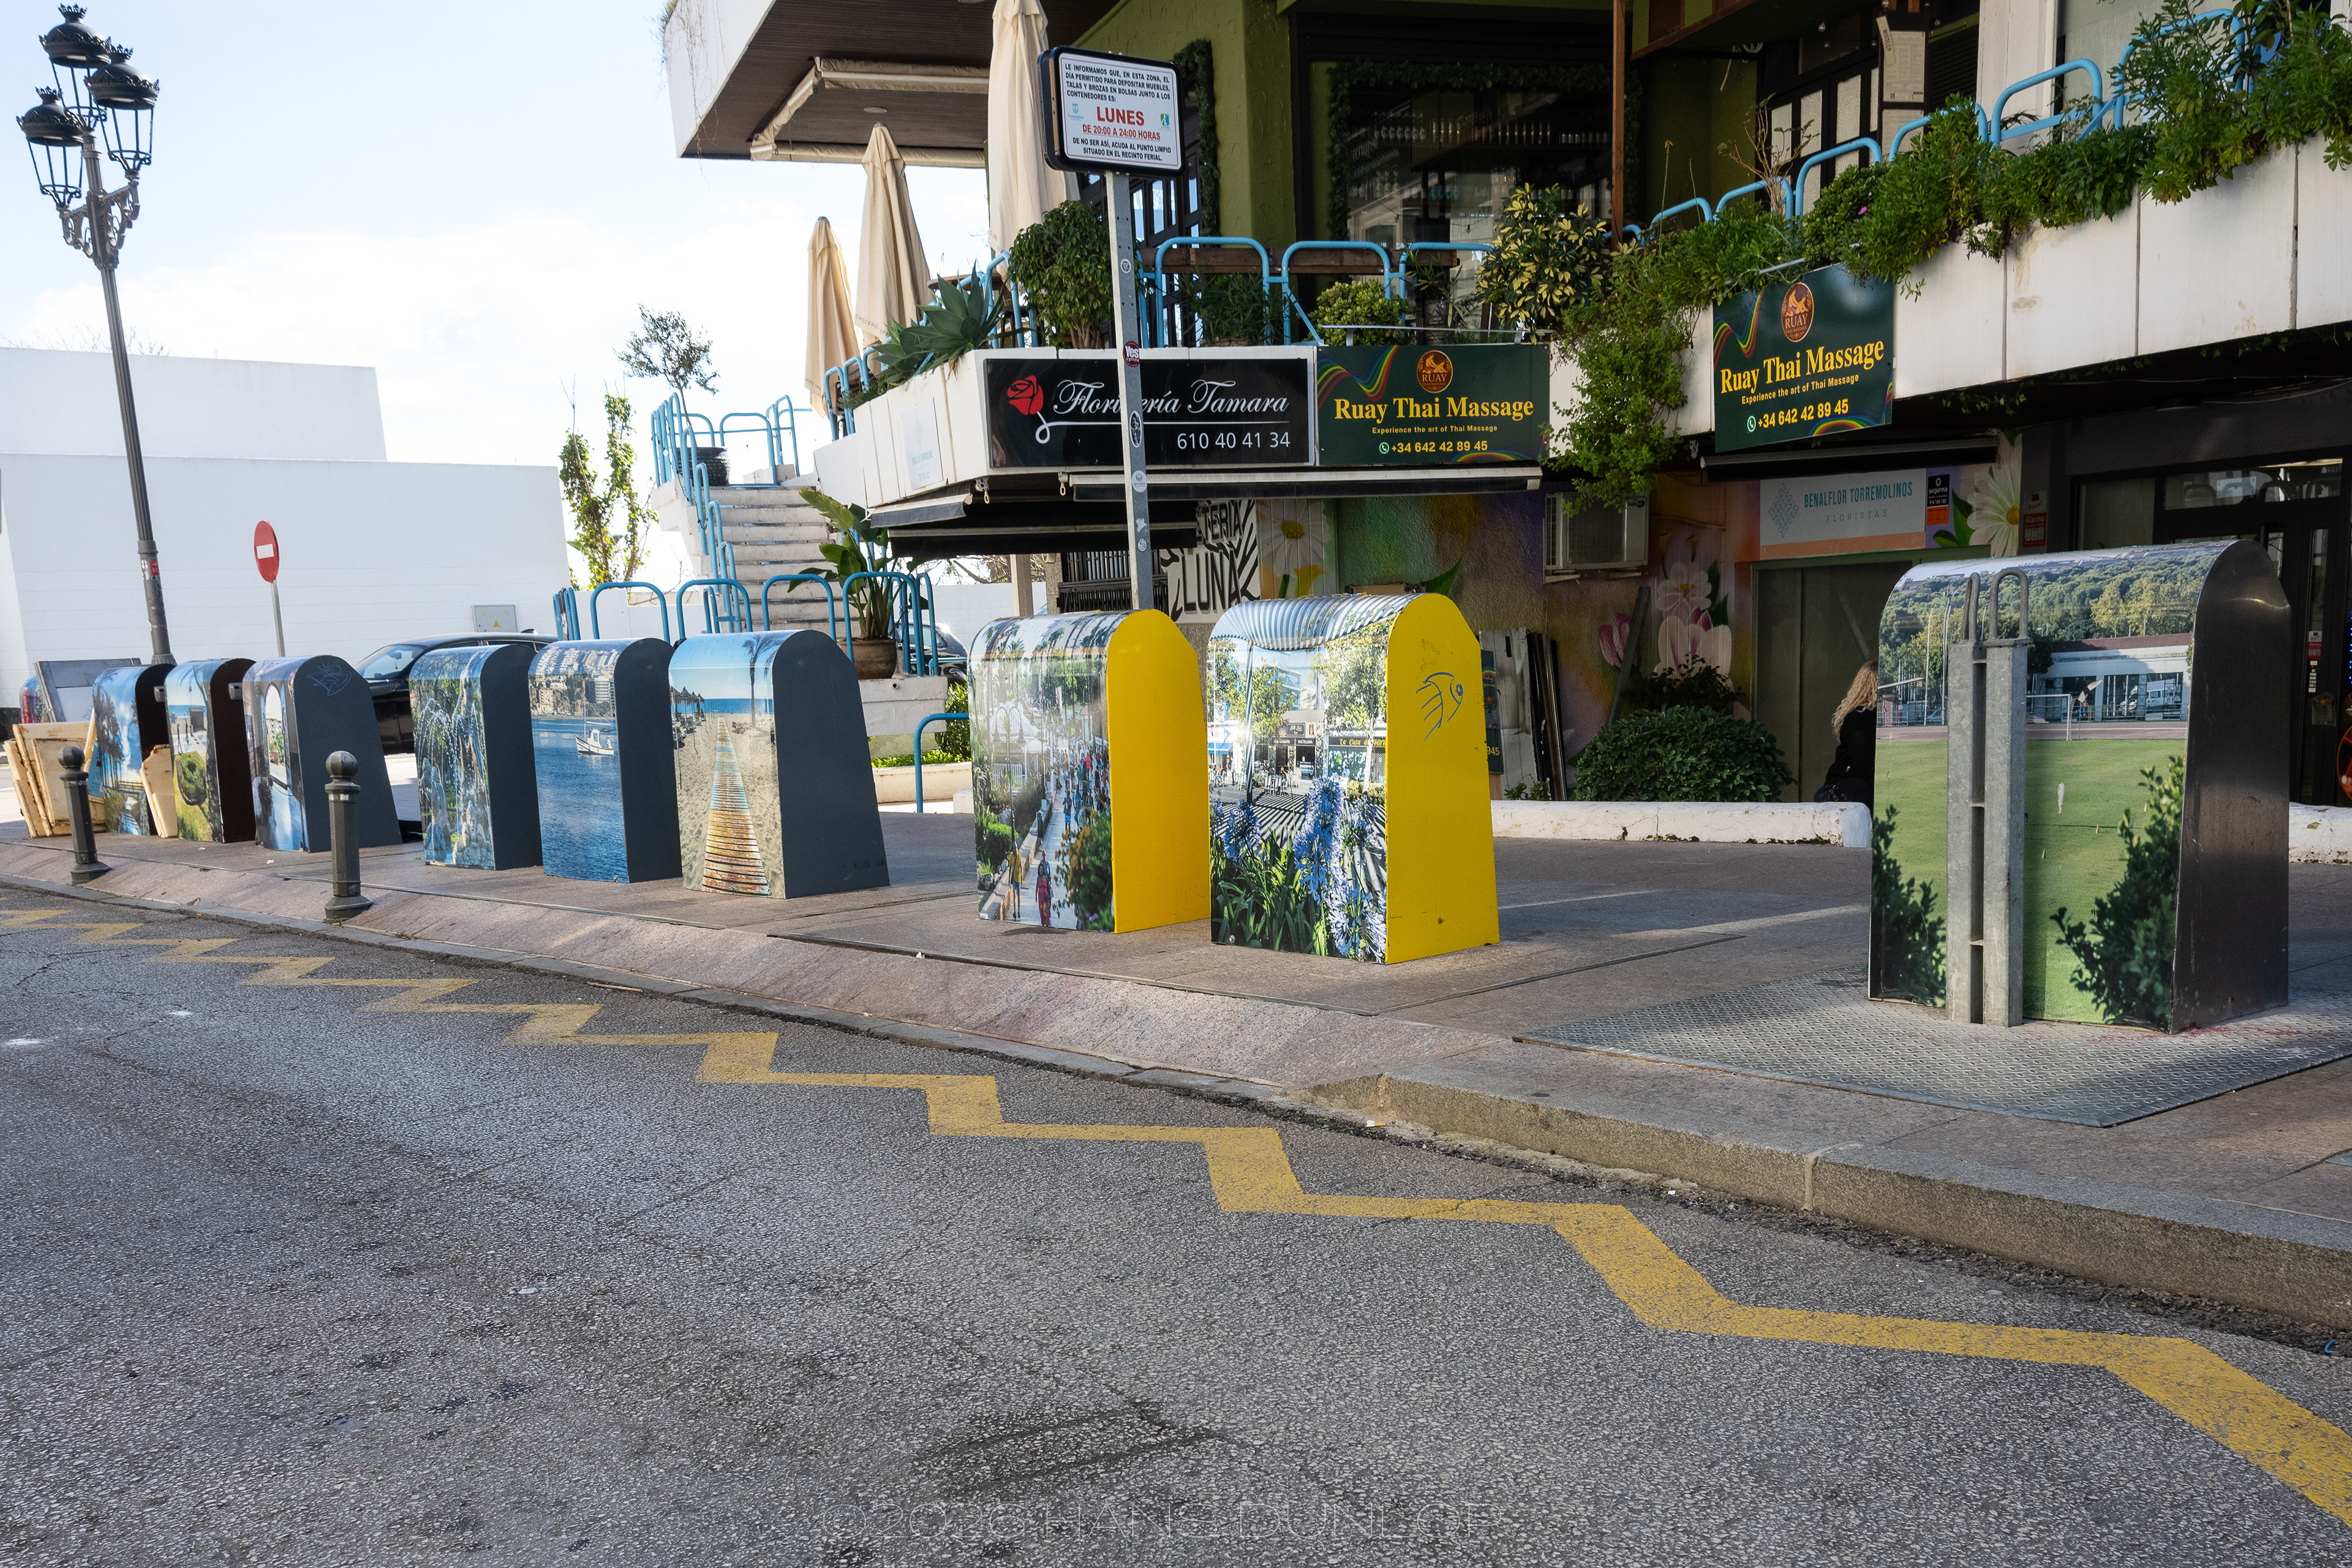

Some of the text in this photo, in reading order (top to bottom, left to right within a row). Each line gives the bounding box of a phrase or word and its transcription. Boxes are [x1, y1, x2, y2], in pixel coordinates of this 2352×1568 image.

[1074, 65, 1107, 75] INFORMAMOS
[1110, 70, 1121, 78] QUE,
[1147, 74, 1161, 83] ZONA,
[1076, 74, 1102, 83] PERMITIDO
[1118, 79, 1145, 88] DEPOSITAR
[1067, 90, 1107, 101] CONTENEDORES
[1089, 84, 1109, 92] BROZAS
[1096, 107, 1145, 126] LUNES
[1083, 124, 1091, 133] DE
[1093, 125, 1111, 135] 20:00
[1119, 129, 1136, 138] 24:00
[1138, 130, 1161, 140] HORAS
[1083, 148, 1104, 156] SITUADO
[1785, 314, 1807, 330] RUAY
[1125, 345, 1139, 358] Yes
[1721, 341, 1884, 394] Ruay Thai Massage
[1422, 374, 1447, 382] RUAY
[1053, 379, 1289, 414] Floriería Tamara
[1742, 391, 1776, 405] Experience
[1778, 388, 1789, 397] the
[1811, 378, 1826, 390] Thai
[1828, 374, 1859, 388] Massage
[1334, 397, 1534, 424] Ruay Thai Massage
[1758, 399, 1849, 428] +34 642 42 89 45
[1372, 426, 1412, 435] Experience
[1177, 431, 1291, 450] 610 40 41 34
[1392, 440, 1488, 453] +34 642 42 89 45
[1804, 481, 1913, 508] BENALFLOR TORREMOLINOS
[1826, 509, 1887, 523] FLORISTAS
[1182, 548, 1242, 614] LUNA
